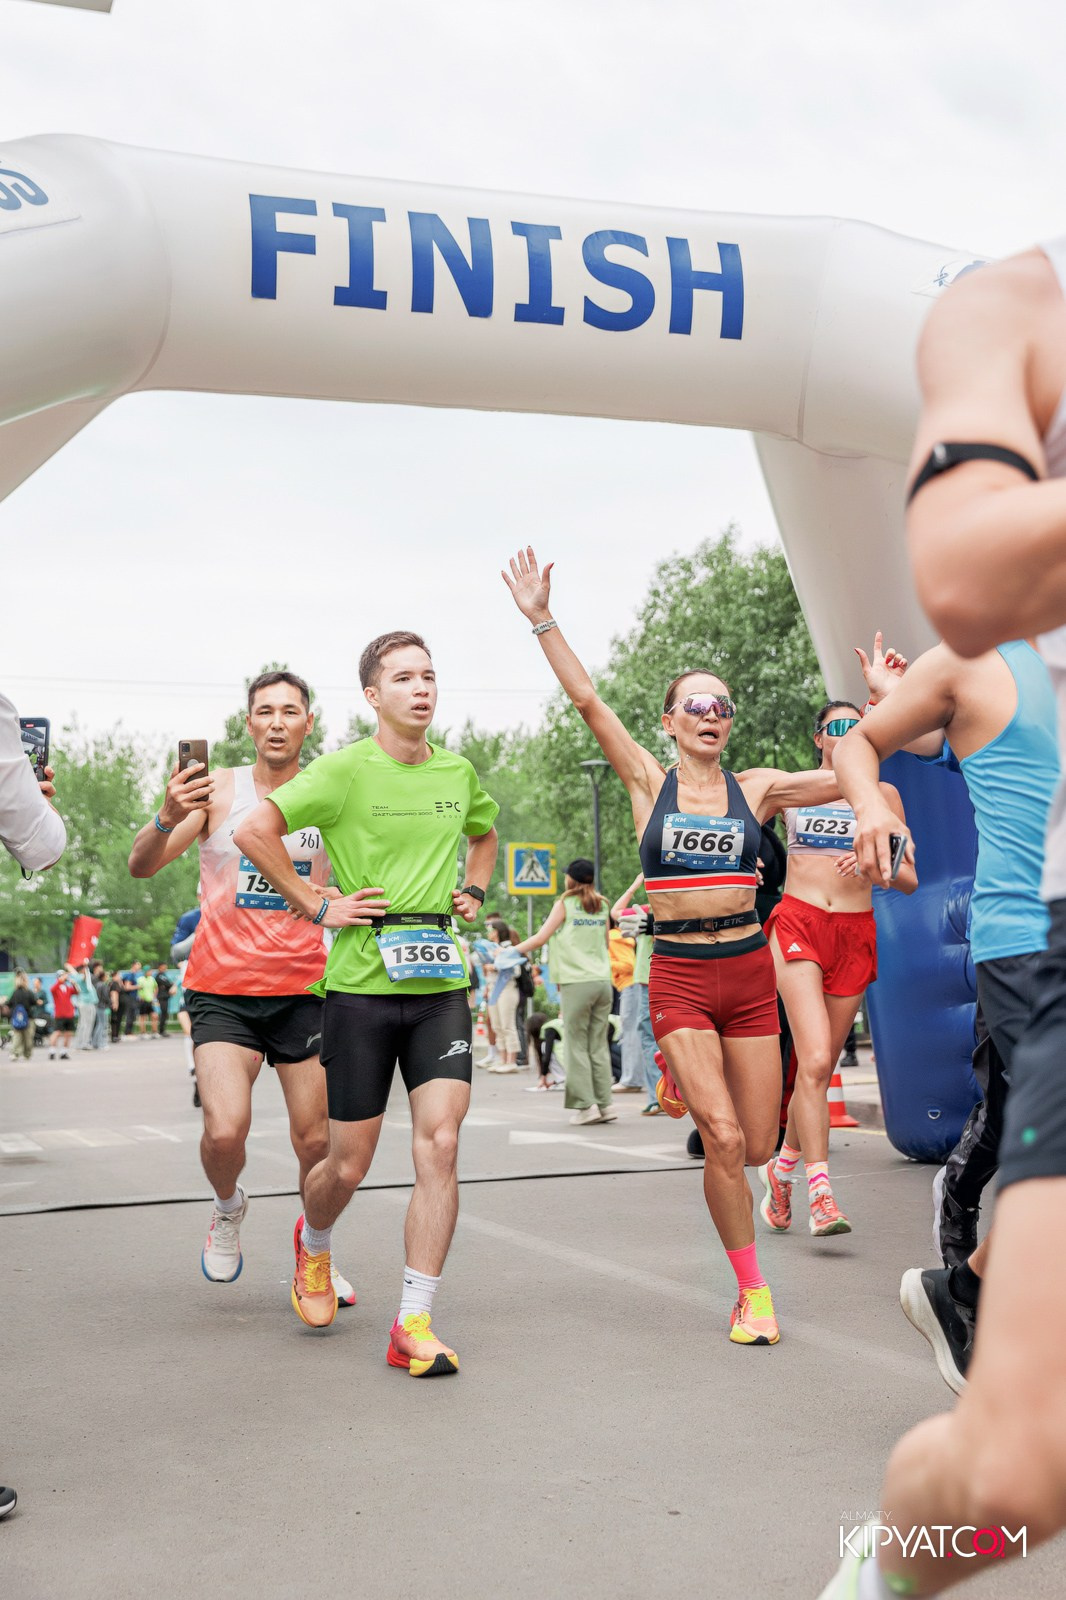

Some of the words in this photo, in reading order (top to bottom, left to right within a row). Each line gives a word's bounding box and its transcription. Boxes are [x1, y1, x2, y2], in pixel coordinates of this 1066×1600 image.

[249, 193, 744, 340] FINISH
[804, 818, 851, 835] 1623
[300, 832, 320, 849] 361
[672, 831, 735, 853] 1666
[242, 859, 249, 867] 5
[392, 944, 451, 964] 1366
